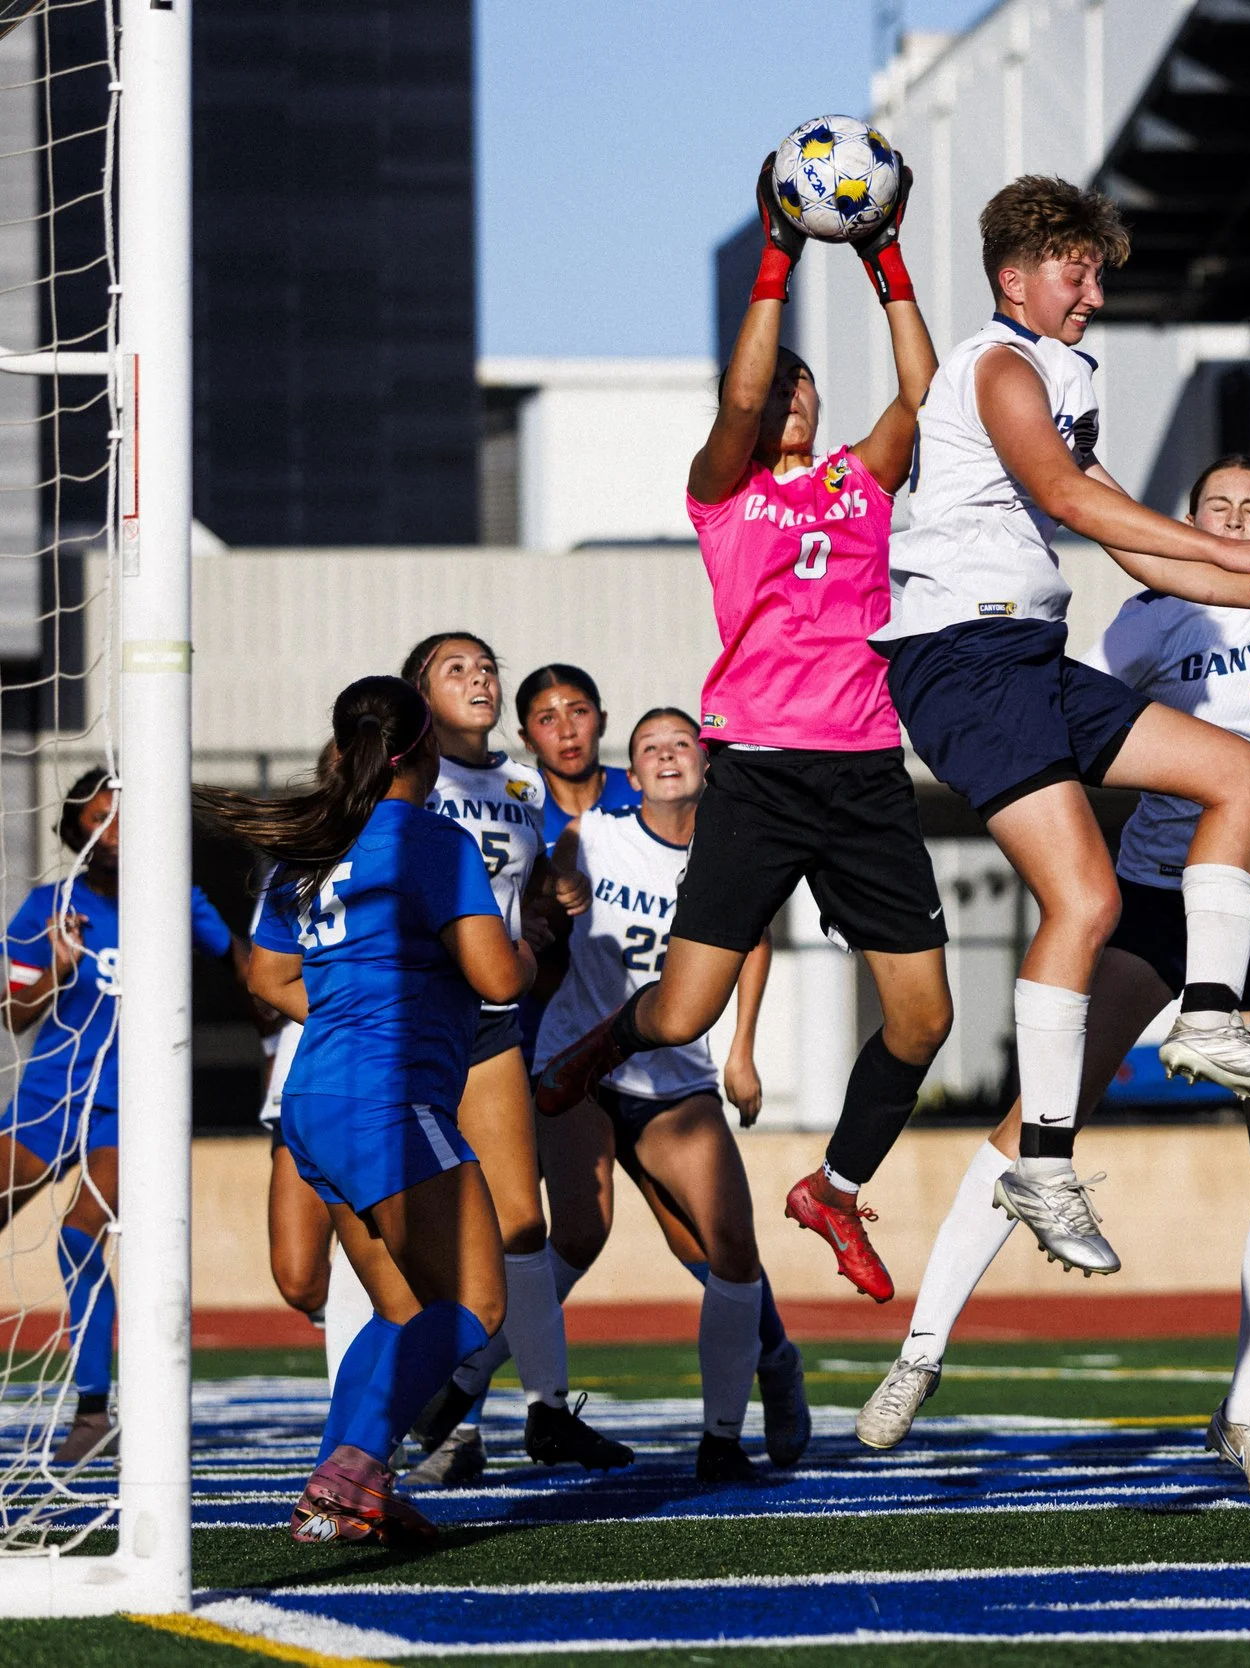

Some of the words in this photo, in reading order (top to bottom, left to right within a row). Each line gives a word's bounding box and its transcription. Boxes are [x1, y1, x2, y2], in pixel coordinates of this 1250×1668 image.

[803, 164, 827, 198] 3C2A
[794, 530, 832, 580] 0
[980, 604, 1006, 612] CANYONS
[427, 799, 535, 830] ANYON
[481, 831, 511, 880] 5
[595, 878, 677, 919] CANY
